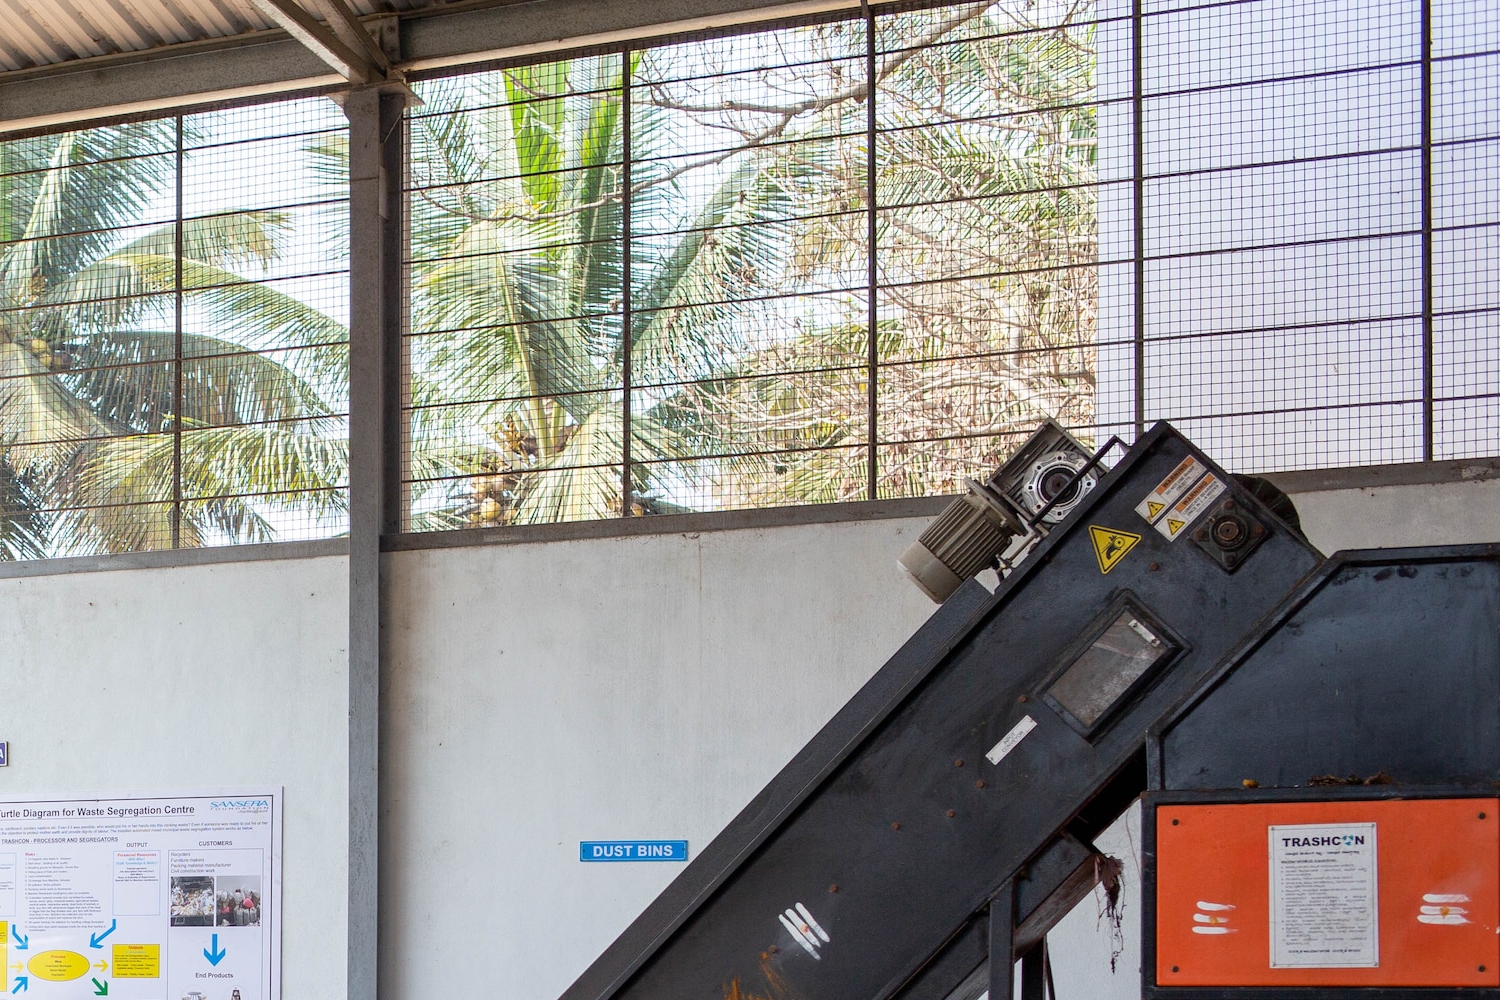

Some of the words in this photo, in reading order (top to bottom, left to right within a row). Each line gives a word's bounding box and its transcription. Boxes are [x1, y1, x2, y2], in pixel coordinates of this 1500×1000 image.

[23, 808, 60, 820] Diagram
[62, 807, 75, 817] for
[77, 806, 105, 816] Waste
[107, 805, 162, 817] Segregation
[164, 805, 195, 815] Centre
[593, 845, 633, 857] DUST
[637, 844, 673, 857] BINS
